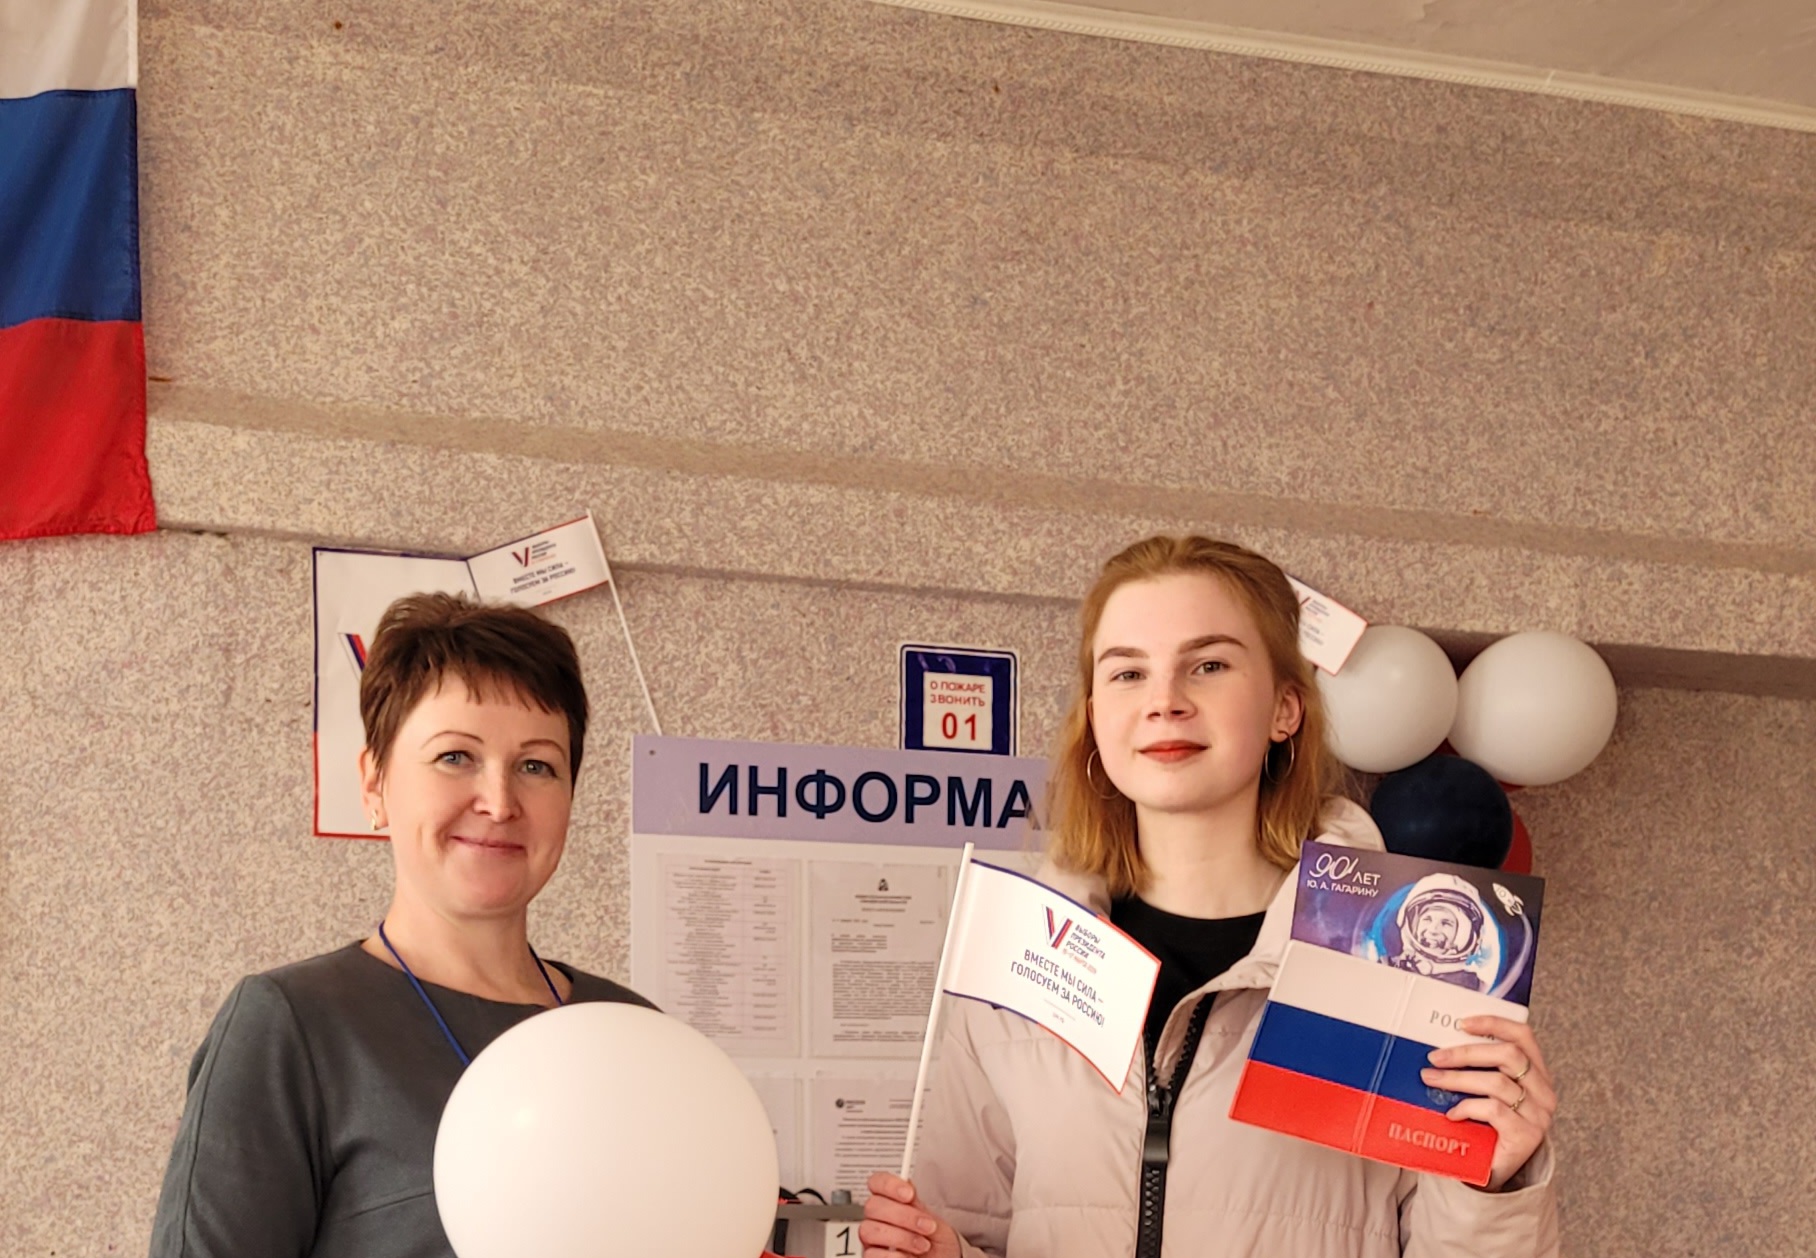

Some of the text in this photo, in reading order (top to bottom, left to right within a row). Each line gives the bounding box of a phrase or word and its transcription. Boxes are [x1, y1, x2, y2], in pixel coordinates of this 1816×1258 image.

[930, 680, 985, 693] О ПОЖАРЕ
[930, 694, 985, 707] ЗВОНИТЬ
[942, 712, 976, 741] 01
[699, 762, 1045, 831] ИНФОРМА
[1331, 882, 1379, 898] ГАГАРИНУ
[1352, 871, 1381, 886] ЛЕТ
[1011, 961, 1060, 995] ГОЛОСУЕМ
[1060, 987, 1070, 1003] ЗА
[1024, 949, 1060, 977] ВМЕСТЕ
[1060, 968, 1076, 988] МЫ
[1076, 979, 1097, 1003] СИЛА
[1388, 1122, 1470, 1157] ПАСПОРТ
[836, 1226, 856, 1257] 1
